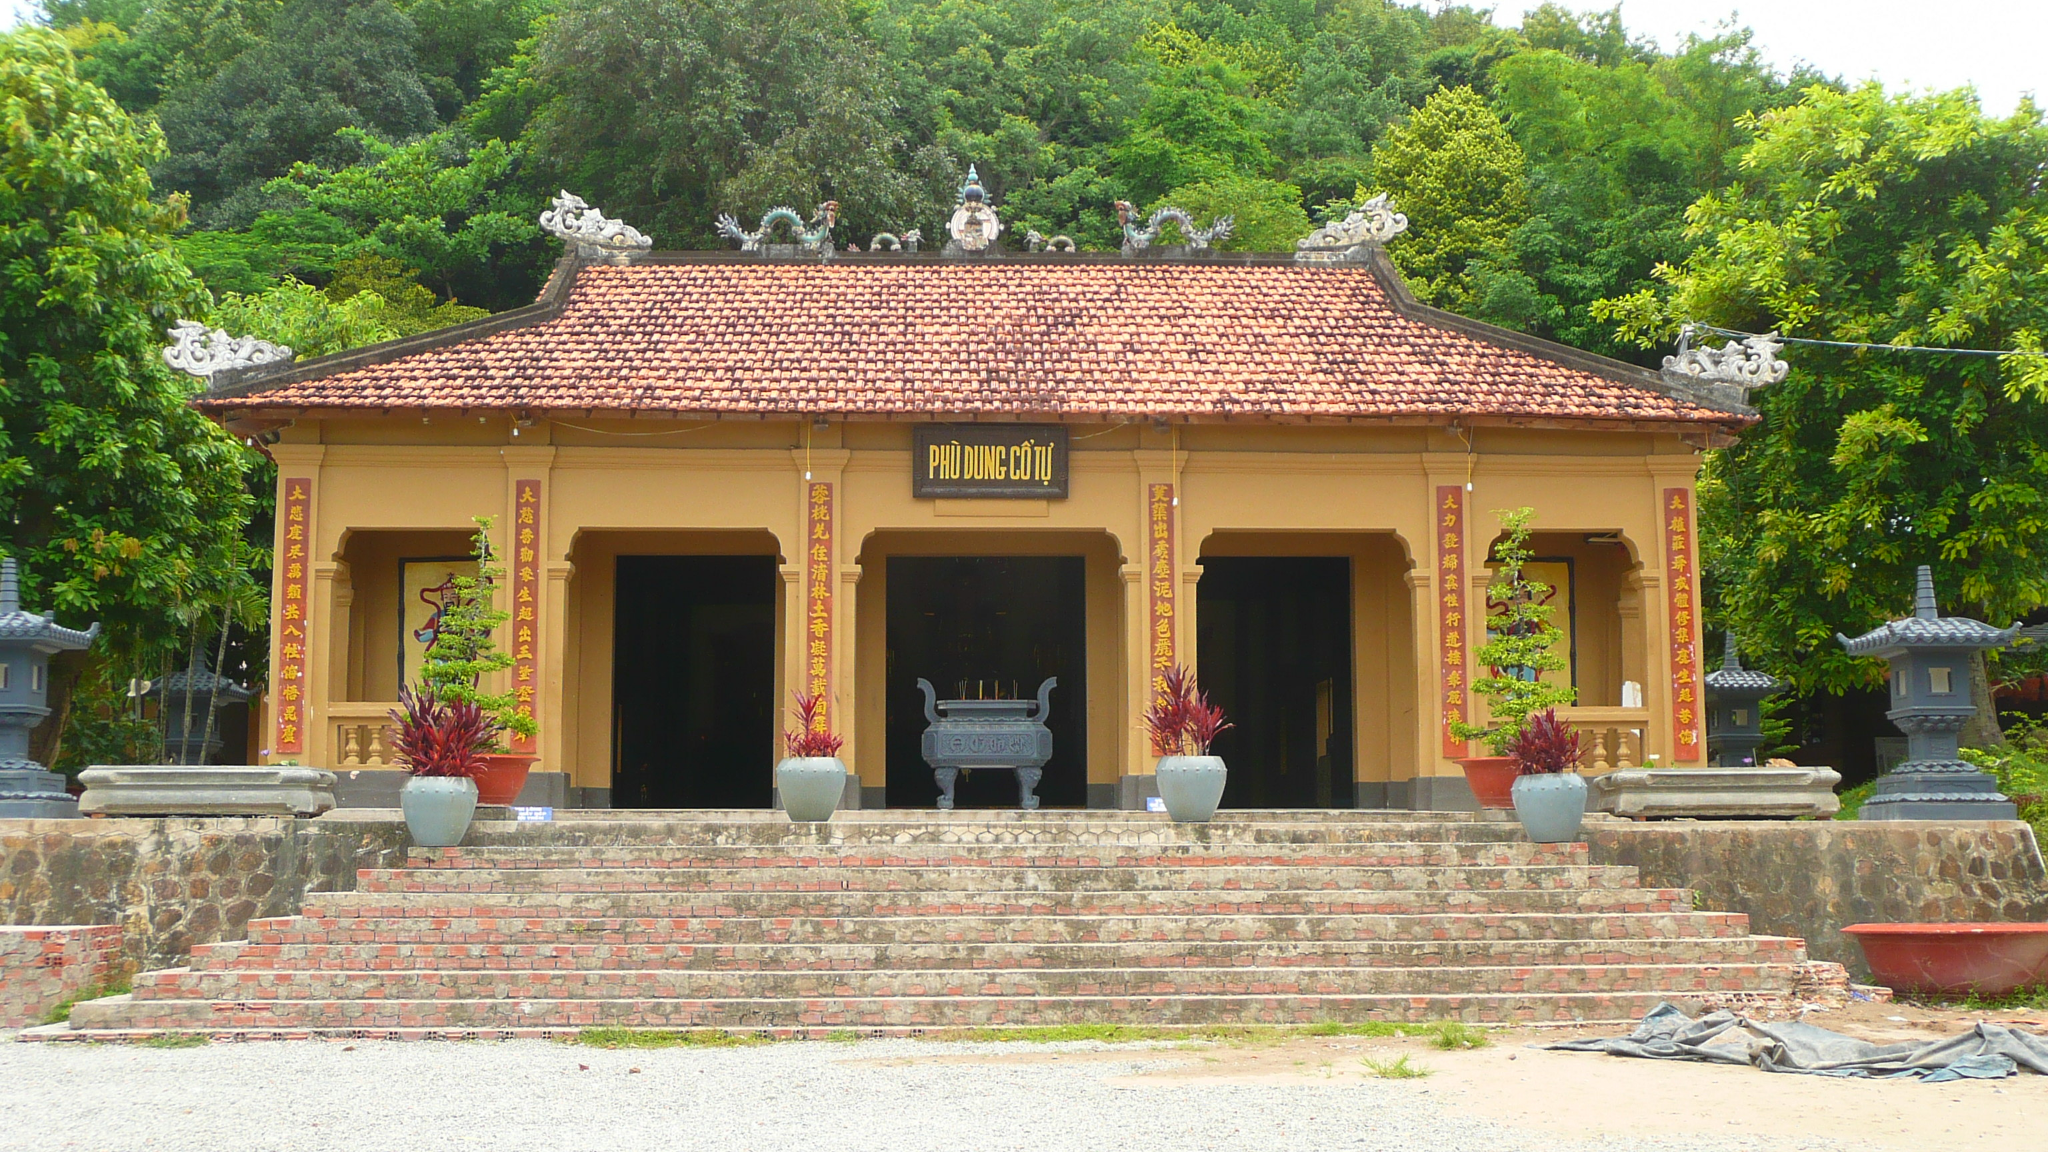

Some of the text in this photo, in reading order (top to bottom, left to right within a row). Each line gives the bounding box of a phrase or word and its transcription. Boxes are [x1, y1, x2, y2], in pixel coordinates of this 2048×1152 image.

[929, 439, 1055, 486] PHÙ DUNG CỔ TỰ
